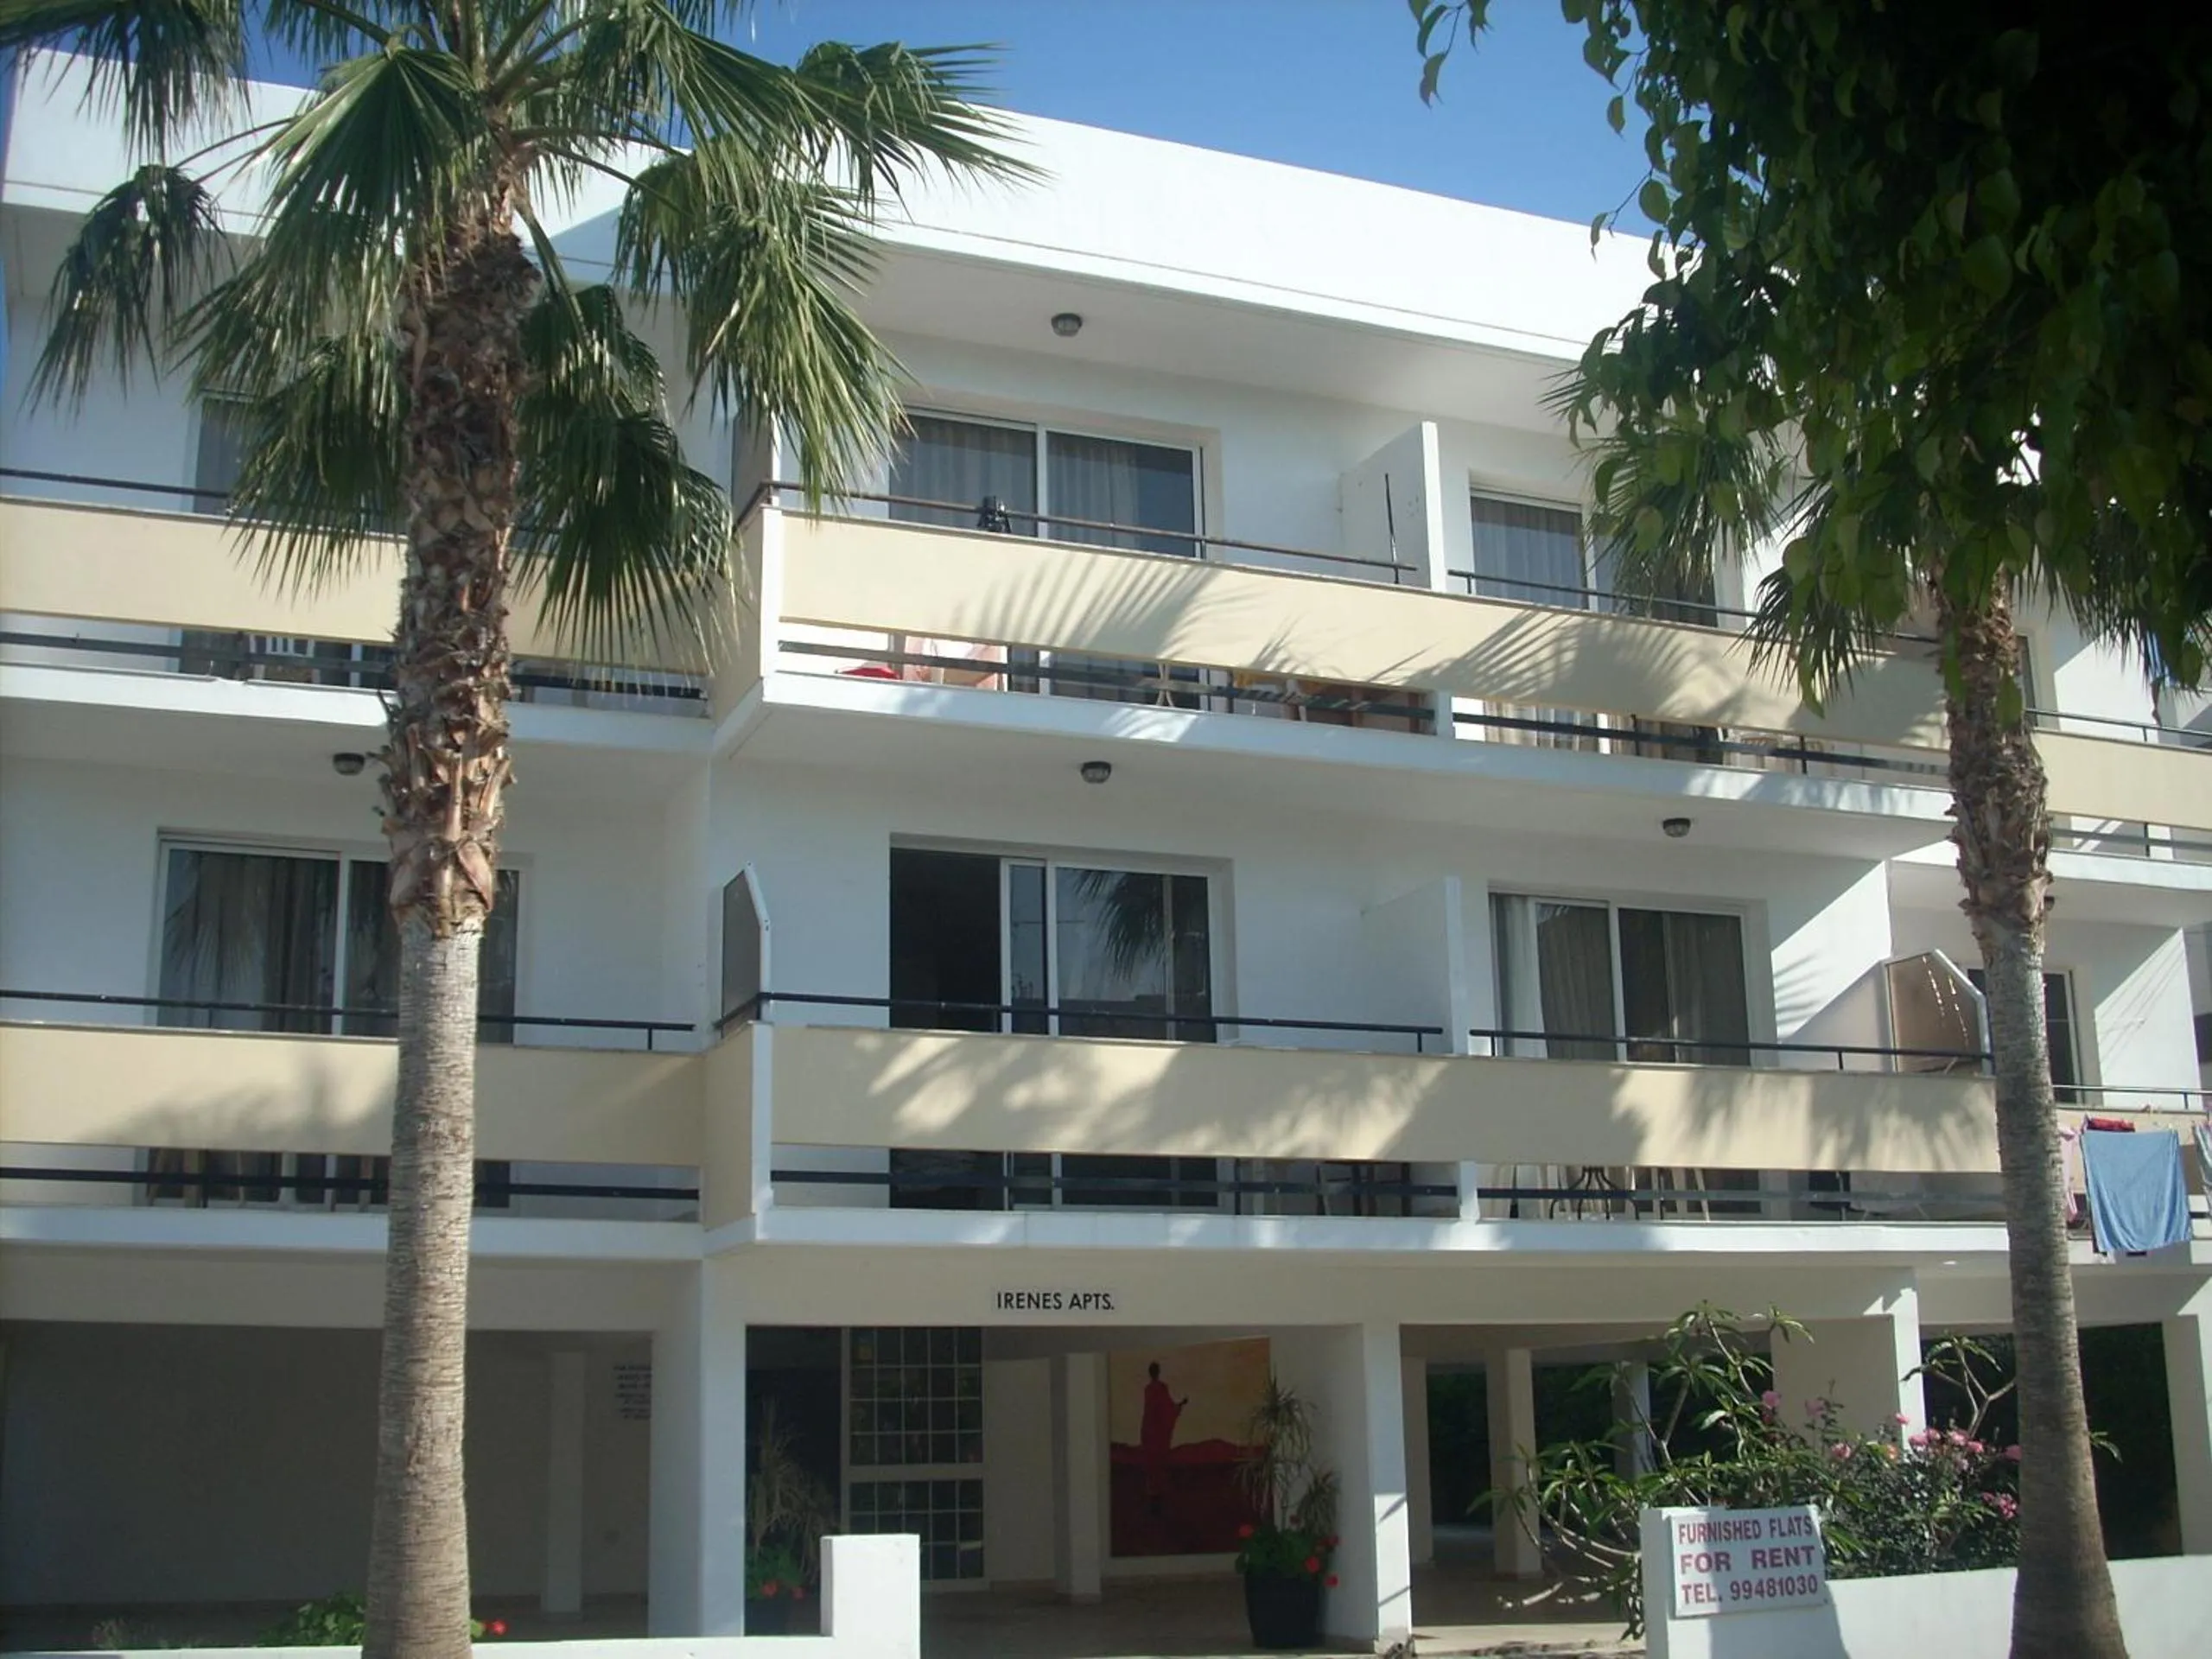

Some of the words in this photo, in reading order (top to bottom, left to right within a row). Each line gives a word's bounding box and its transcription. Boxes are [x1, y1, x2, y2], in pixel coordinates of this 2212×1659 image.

[997, 1292, 1063, 1311] IRENES
[1068, 1293, 1115, 1311] APTS.
[1679, 1519, 1762, 1545] FURNISHED
[1770, 1515, 1813, 1539] FLATS
[1681, 1551, 1732, 1575] FOR
[1751, 1545, 1815, 1571] RENT
[1681, 1583, 1723, 1605] TEL.
[1730, 1573, 1818, 1602] 99481030
